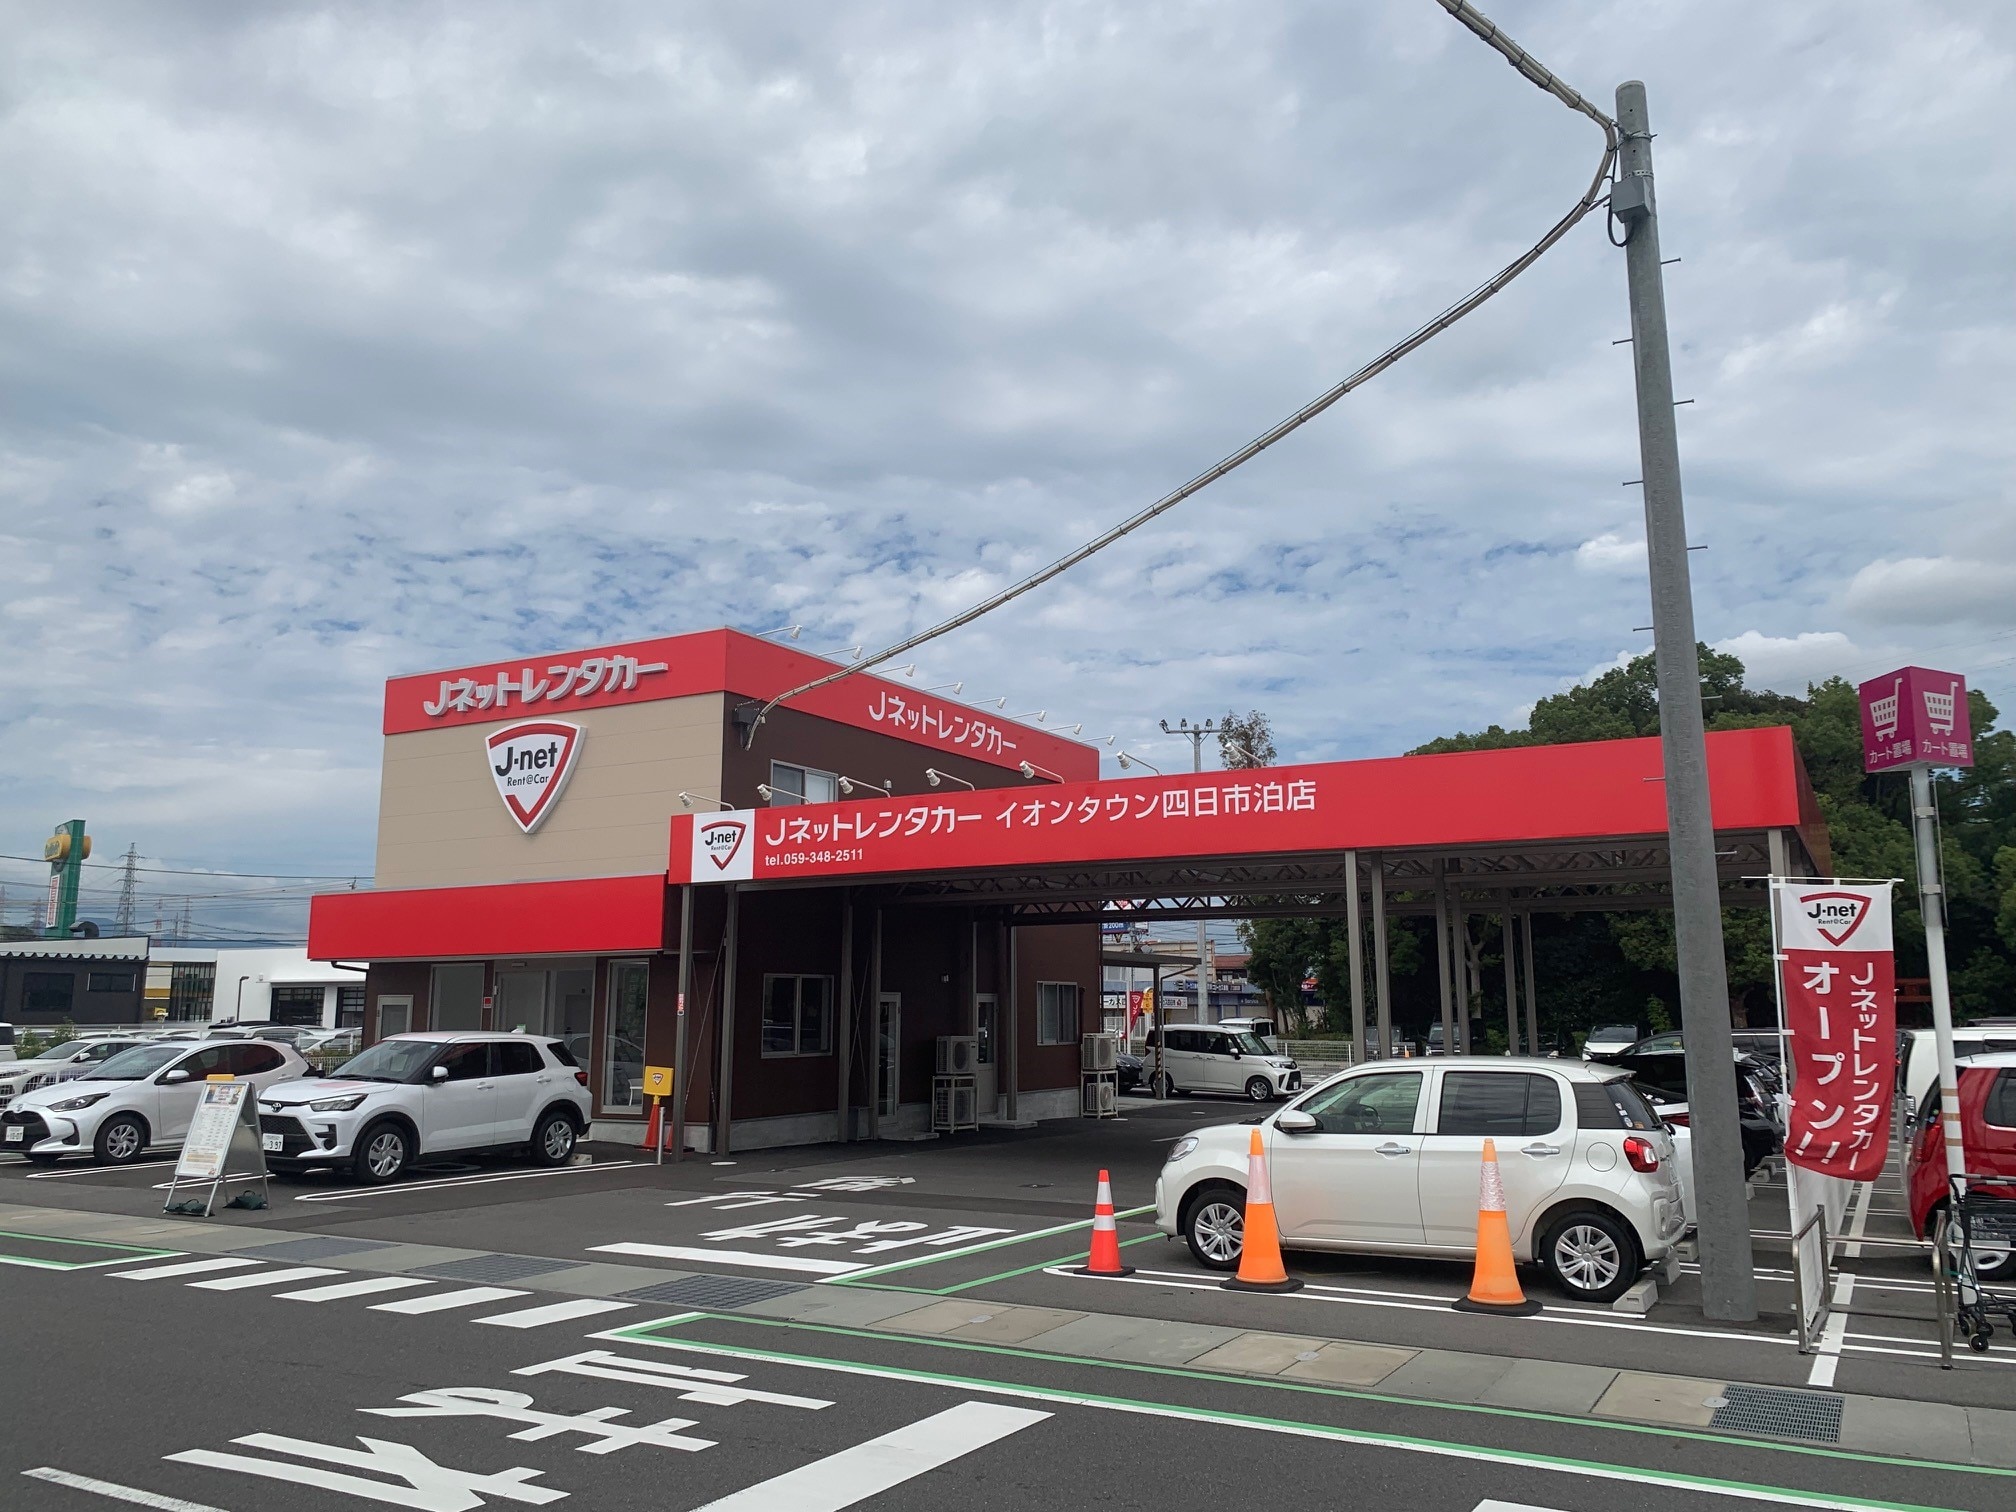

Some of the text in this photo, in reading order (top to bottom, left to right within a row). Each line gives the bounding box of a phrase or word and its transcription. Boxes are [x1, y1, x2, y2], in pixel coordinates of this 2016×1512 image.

[423, 655, 669, 717] Jネットレンタカー
[868, 690, 1017, 756] Jネットレンタカー
[1869, 739, 1913, 764] カート置場
[1922, 739, 1968, 759] カート置場
[507, 773, 550, 787] Rent@Car
[765, 779, 1318, 846] Jネットレンタカー イオンタウン四日市泊店
[765, 848, 864, 867] tel.059-348-2511
[1849, 962, 1879, 1171] Jネットレンタカー
